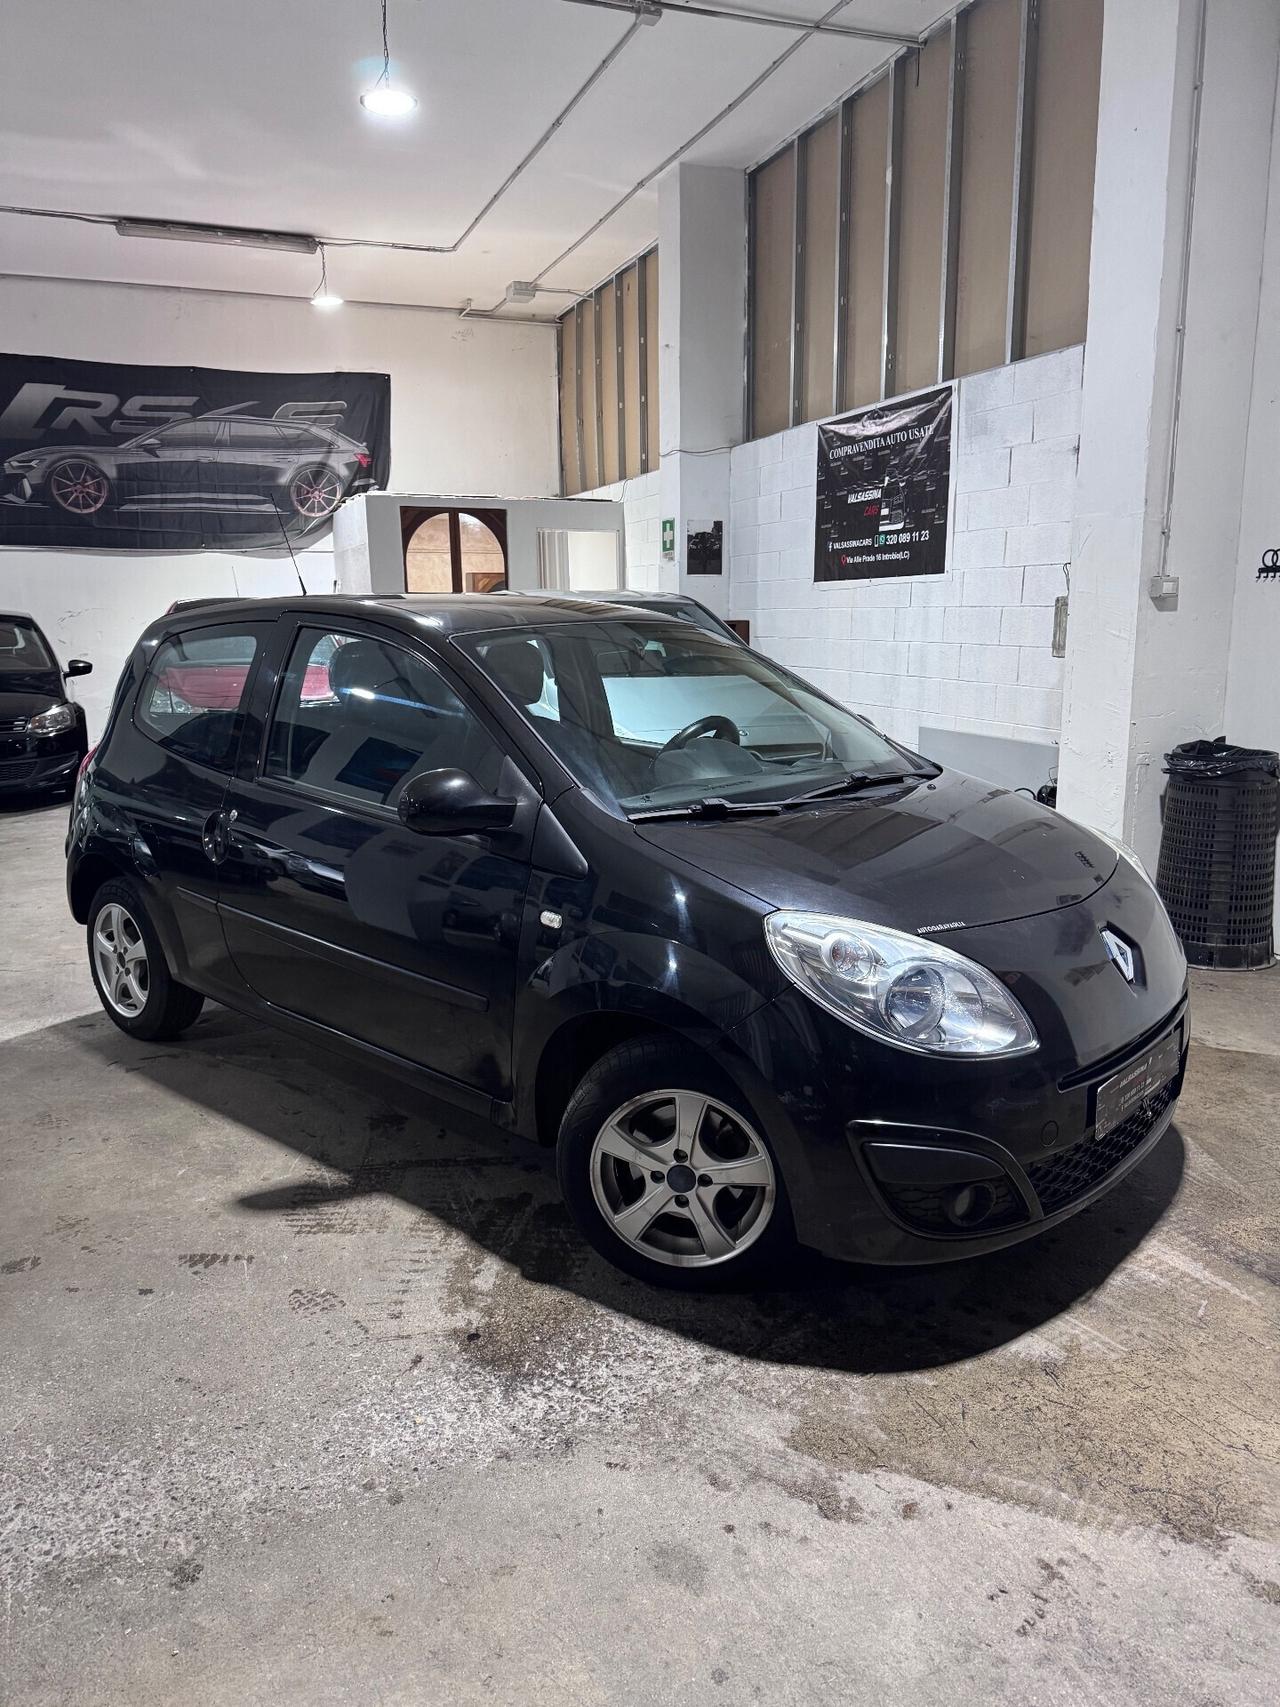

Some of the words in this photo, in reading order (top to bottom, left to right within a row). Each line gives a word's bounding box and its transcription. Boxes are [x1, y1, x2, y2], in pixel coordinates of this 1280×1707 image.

[829, 436, 885, 459] COMPRAVENDITA
[884, 430, 907, 446] AUTO
[847, 488, 882, 504] VALSASSINA
[833, 538, 872, 549] VALSASSINACARS
[886, 534, 897, 545] 320
[899, 532, 911, 543] 089
[912, 532, 919, 542] 11
[920, 530, 930, 541] 23
